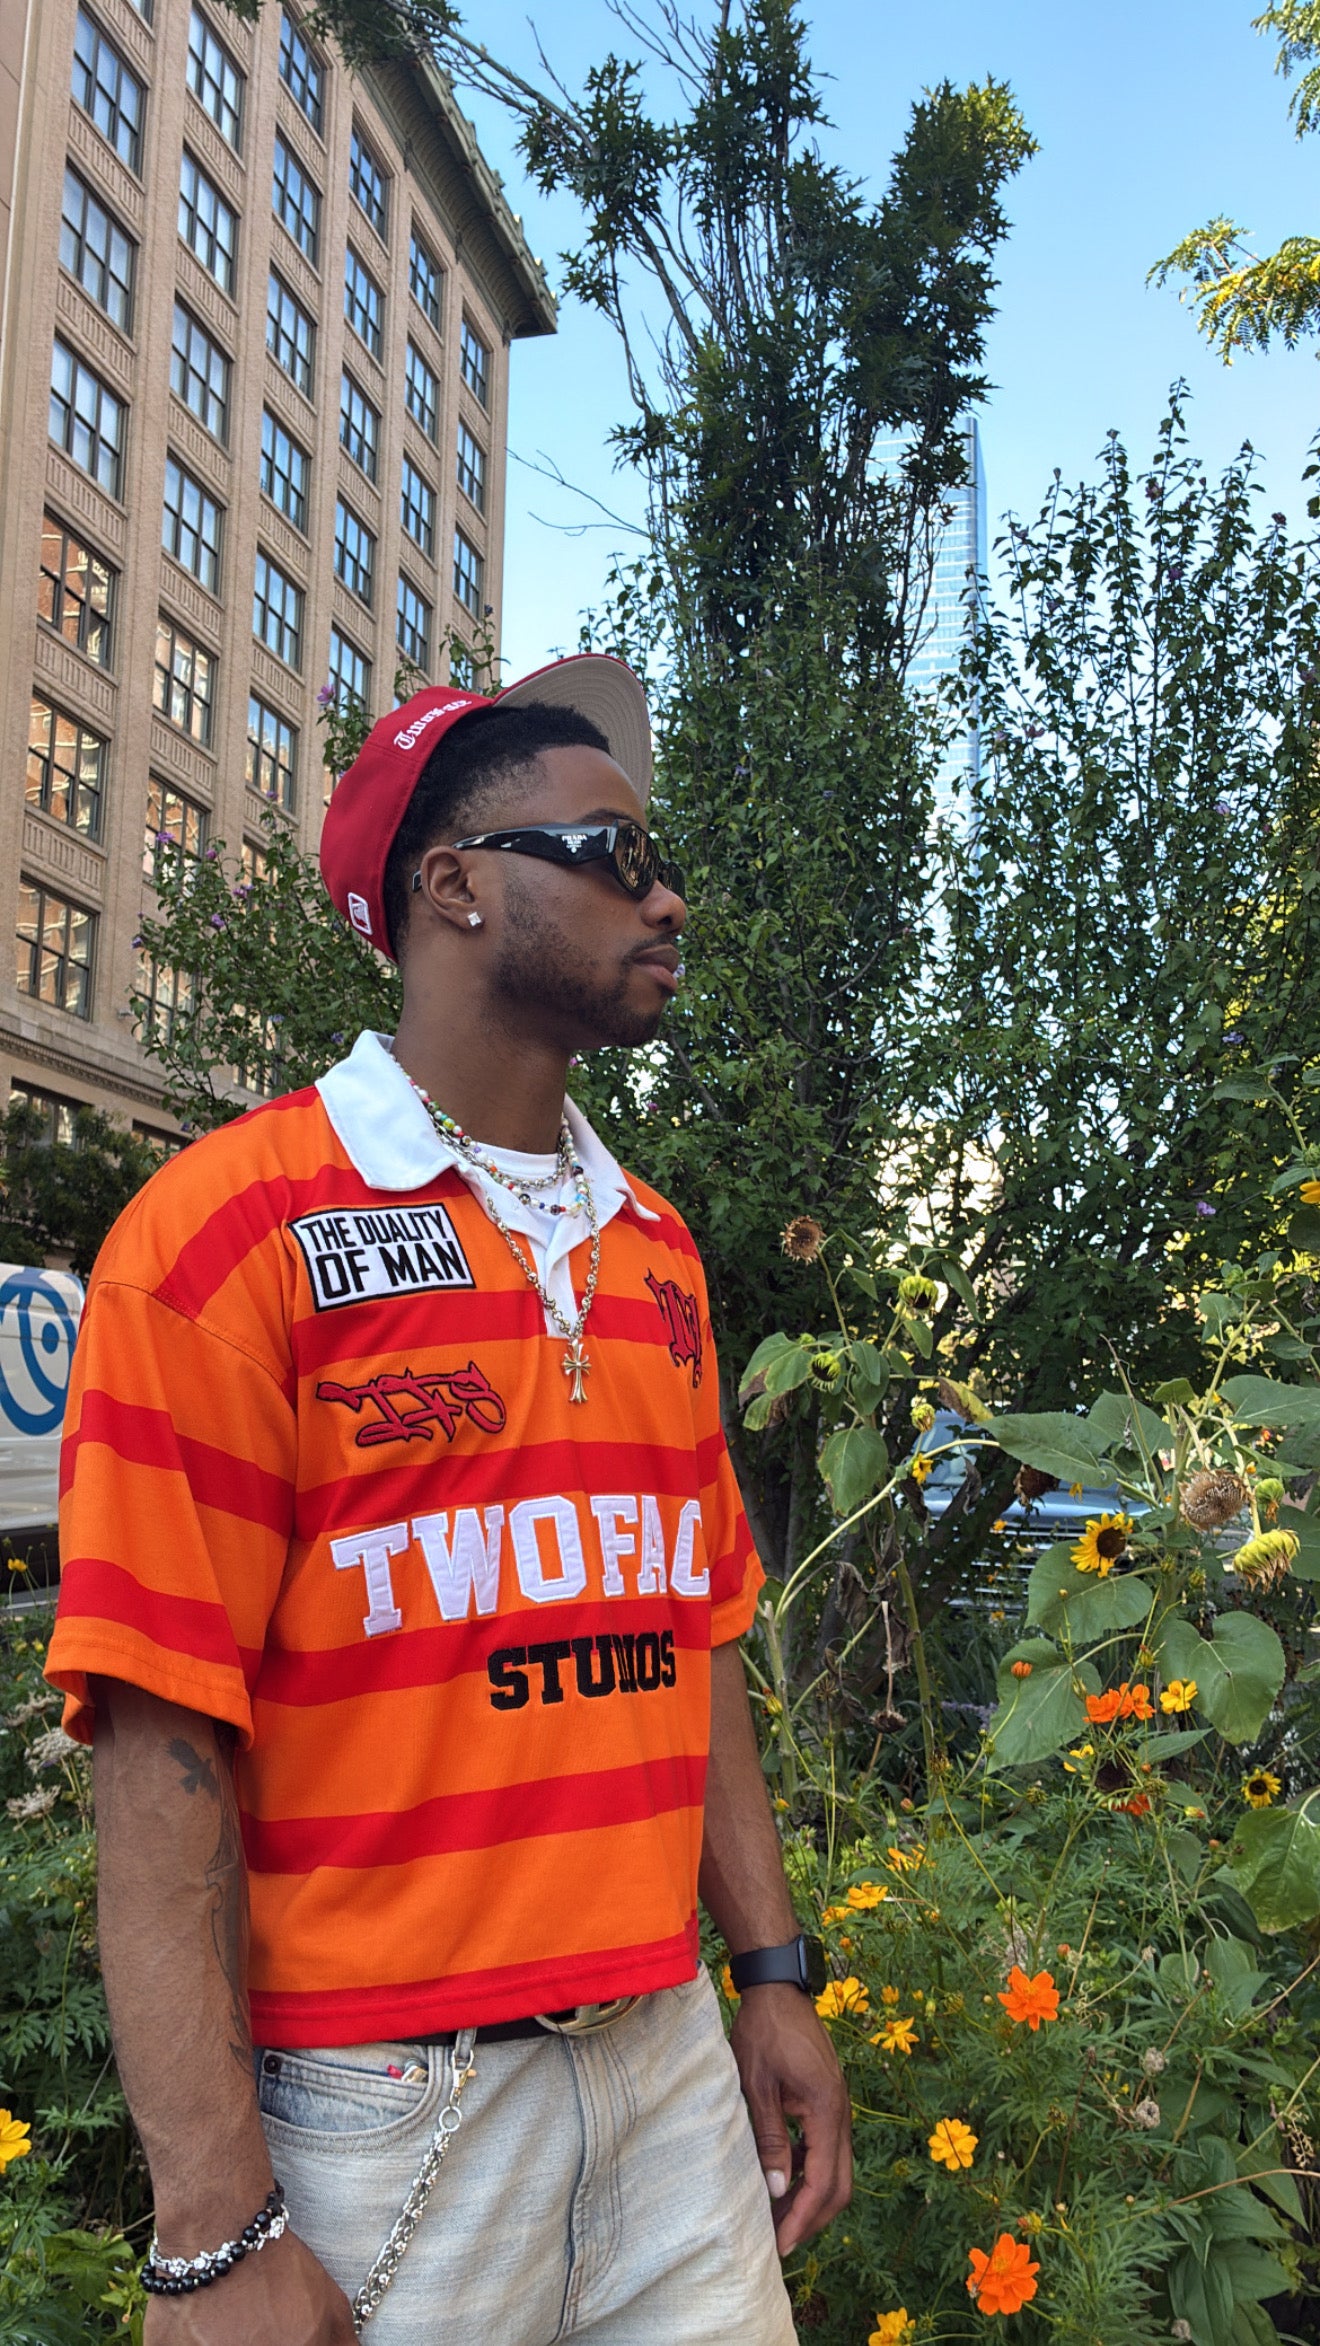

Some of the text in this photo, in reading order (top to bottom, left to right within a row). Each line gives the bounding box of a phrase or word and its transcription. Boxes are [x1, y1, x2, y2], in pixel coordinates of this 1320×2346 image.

[300, 1210, 448, 1252] THE DUALITY
[315, 1241, 467, 1300] OF MAN
